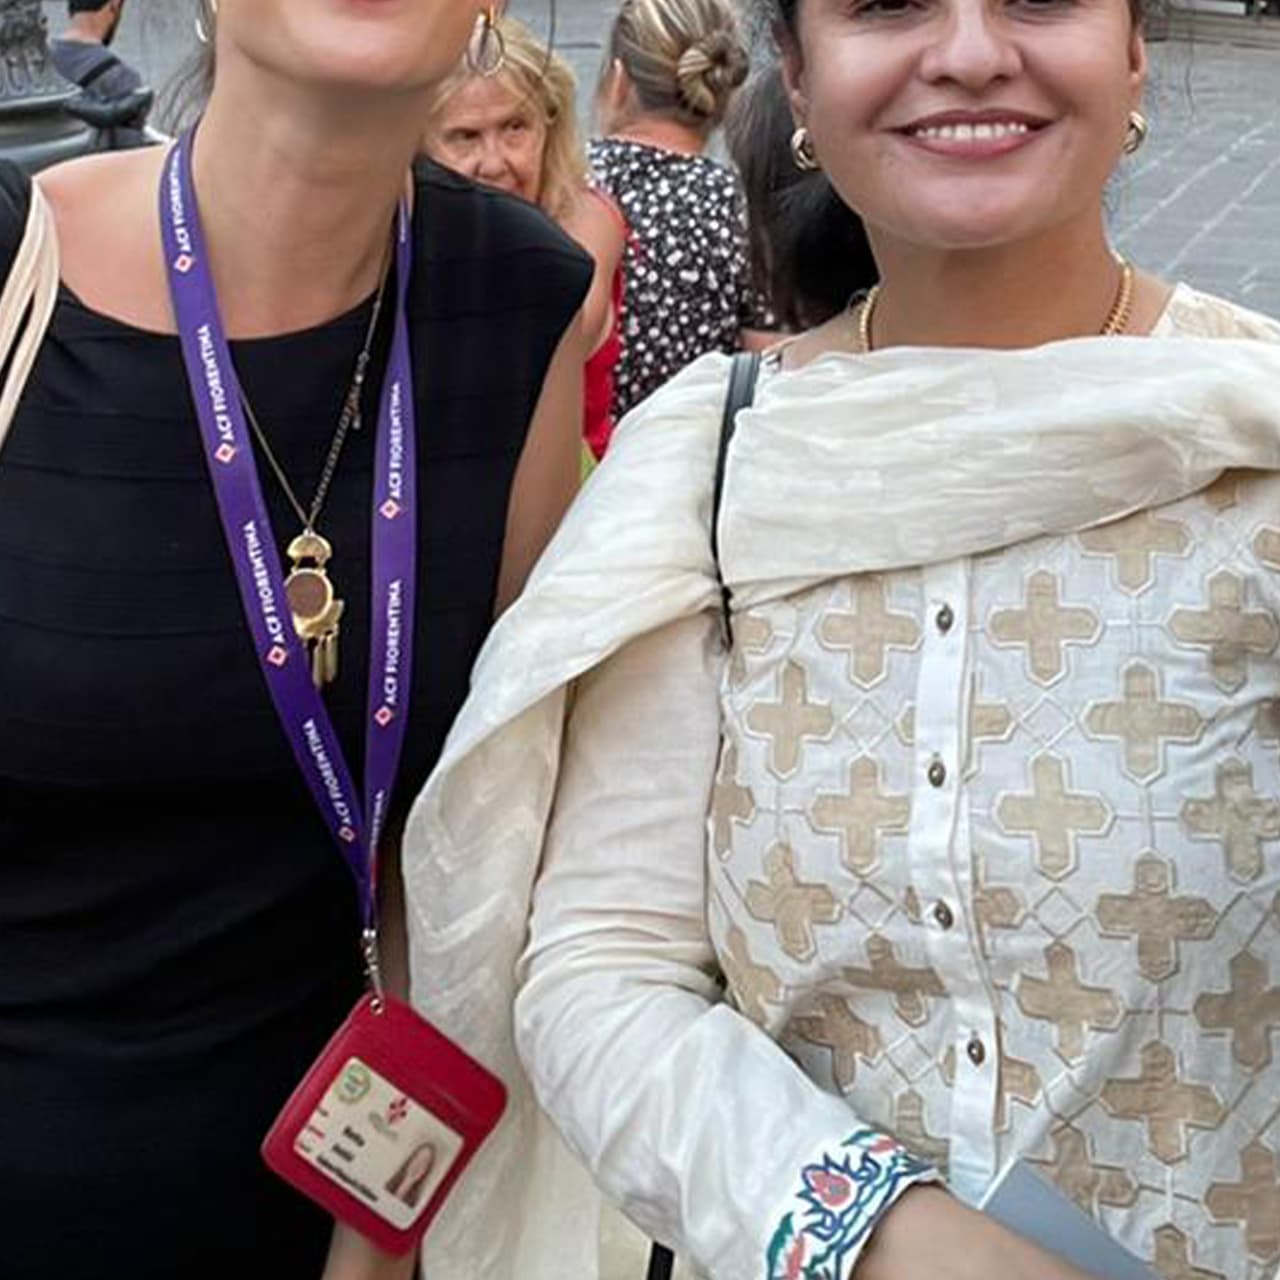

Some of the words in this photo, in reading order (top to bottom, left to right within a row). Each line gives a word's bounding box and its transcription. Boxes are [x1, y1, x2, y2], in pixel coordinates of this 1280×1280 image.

[175, 227, 191, 251] ACF
[198, 325, 226, 411] FIORENTINA
[216, 414, 234, 440] ACF
[390, 383, 403, 469] FIORENTINA
[389, 472, 402, 500] ACF
[244, 521, 275, 613] FIORENTINA
[266, 616, 284, 643] ACF
[386, 580, 400, 672] FIORENTINA
[385, 677, 397, 704] ACF
[304, 719, 342, 798] FIORENTINA
[334, 801, 351, 828] ACF
